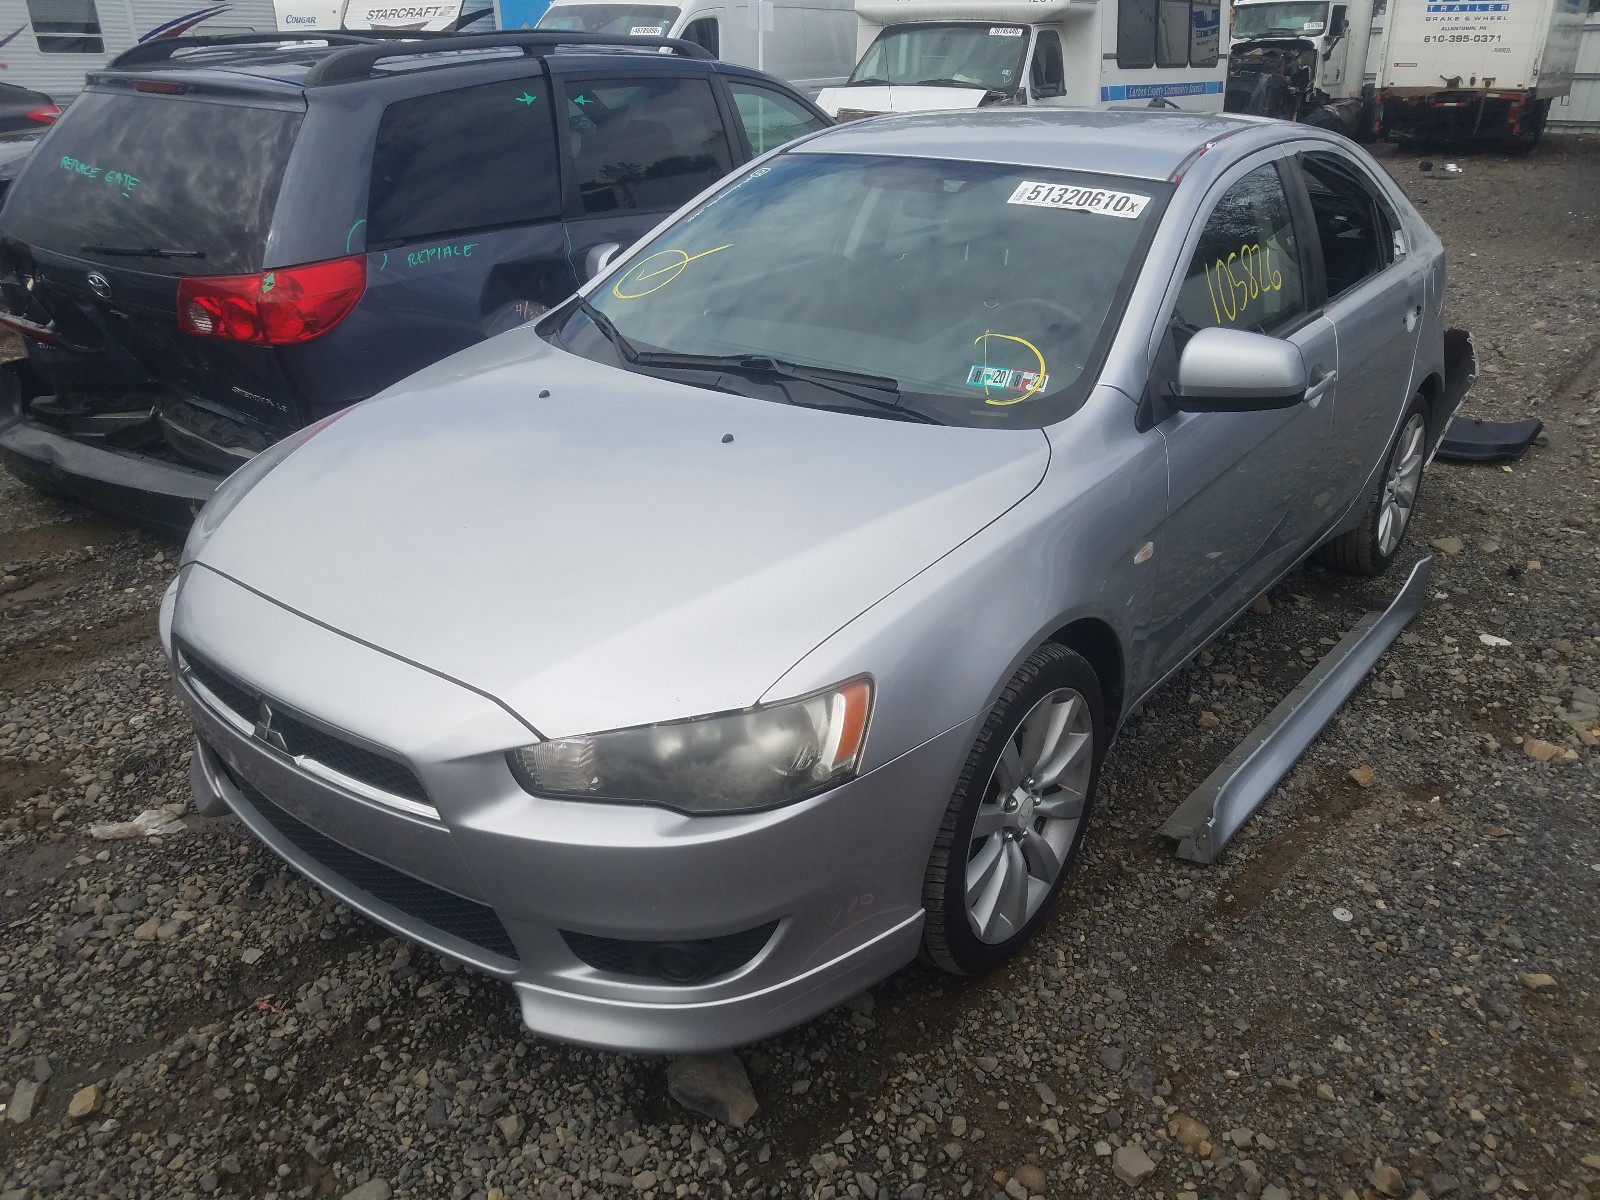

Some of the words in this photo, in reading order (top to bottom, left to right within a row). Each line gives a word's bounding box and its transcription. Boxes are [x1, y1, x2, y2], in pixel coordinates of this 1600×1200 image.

[366, 6, 442, 20] STARCRAFT
[1428, 4, 1509, 12] TRAILER
[285, 14, 317, 24] COUGAR
[1423, 34, 1502, 43] 610-395-0371
[1204, 243, 1282, 325] 105826
[993, 369, 1007, 384] 20
